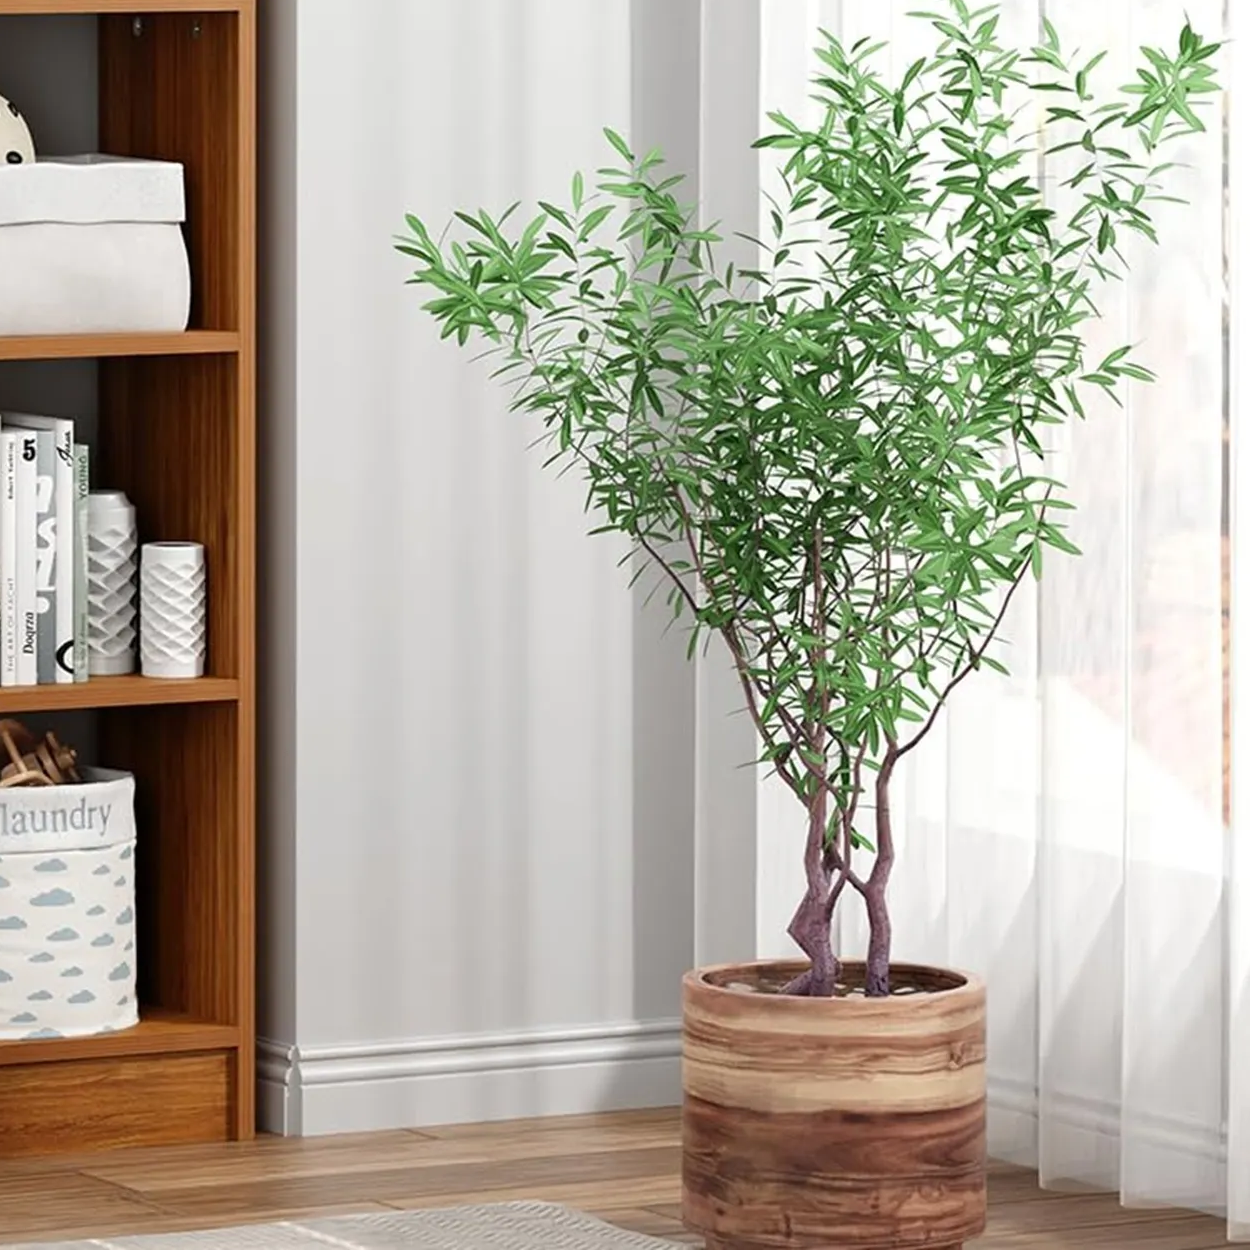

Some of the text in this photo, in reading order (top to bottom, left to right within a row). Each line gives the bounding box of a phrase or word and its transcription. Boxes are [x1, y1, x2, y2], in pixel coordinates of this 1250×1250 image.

[22, 439, 36, 461] 5
[78, 455, 88, 500] YOUNG
[0, 797, 112, 836] laundry
